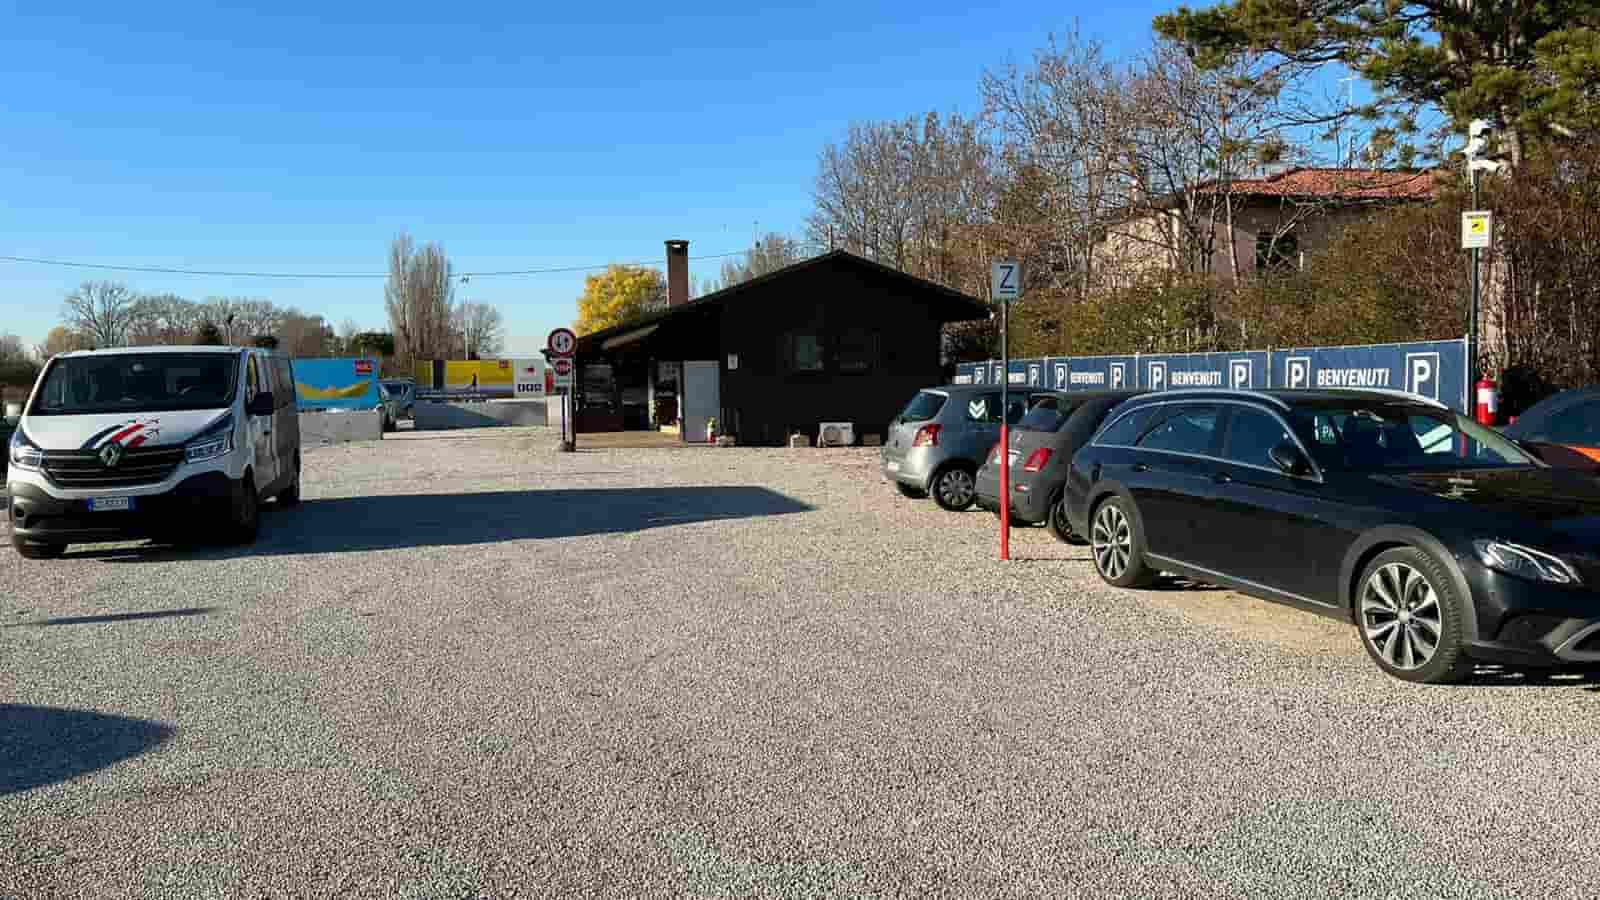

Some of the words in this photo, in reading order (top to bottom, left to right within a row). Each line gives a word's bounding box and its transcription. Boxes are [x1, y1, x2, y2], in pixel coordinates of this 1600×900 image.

[1000, 265, 1015, 289] Z
[1057, 366, 1065, 388] P
[1112, 366, 1122, 389] P
[1152, 366, 1163, 391] P
[1171, 371, 1221, 385] BENVENUTI
[1233, 364, 1247, 389] P
[1291, 362, 1305, 388] P
[1317, 368, 1390, 386] BENVENUTI
[1412, 359, 1431, 393] P
